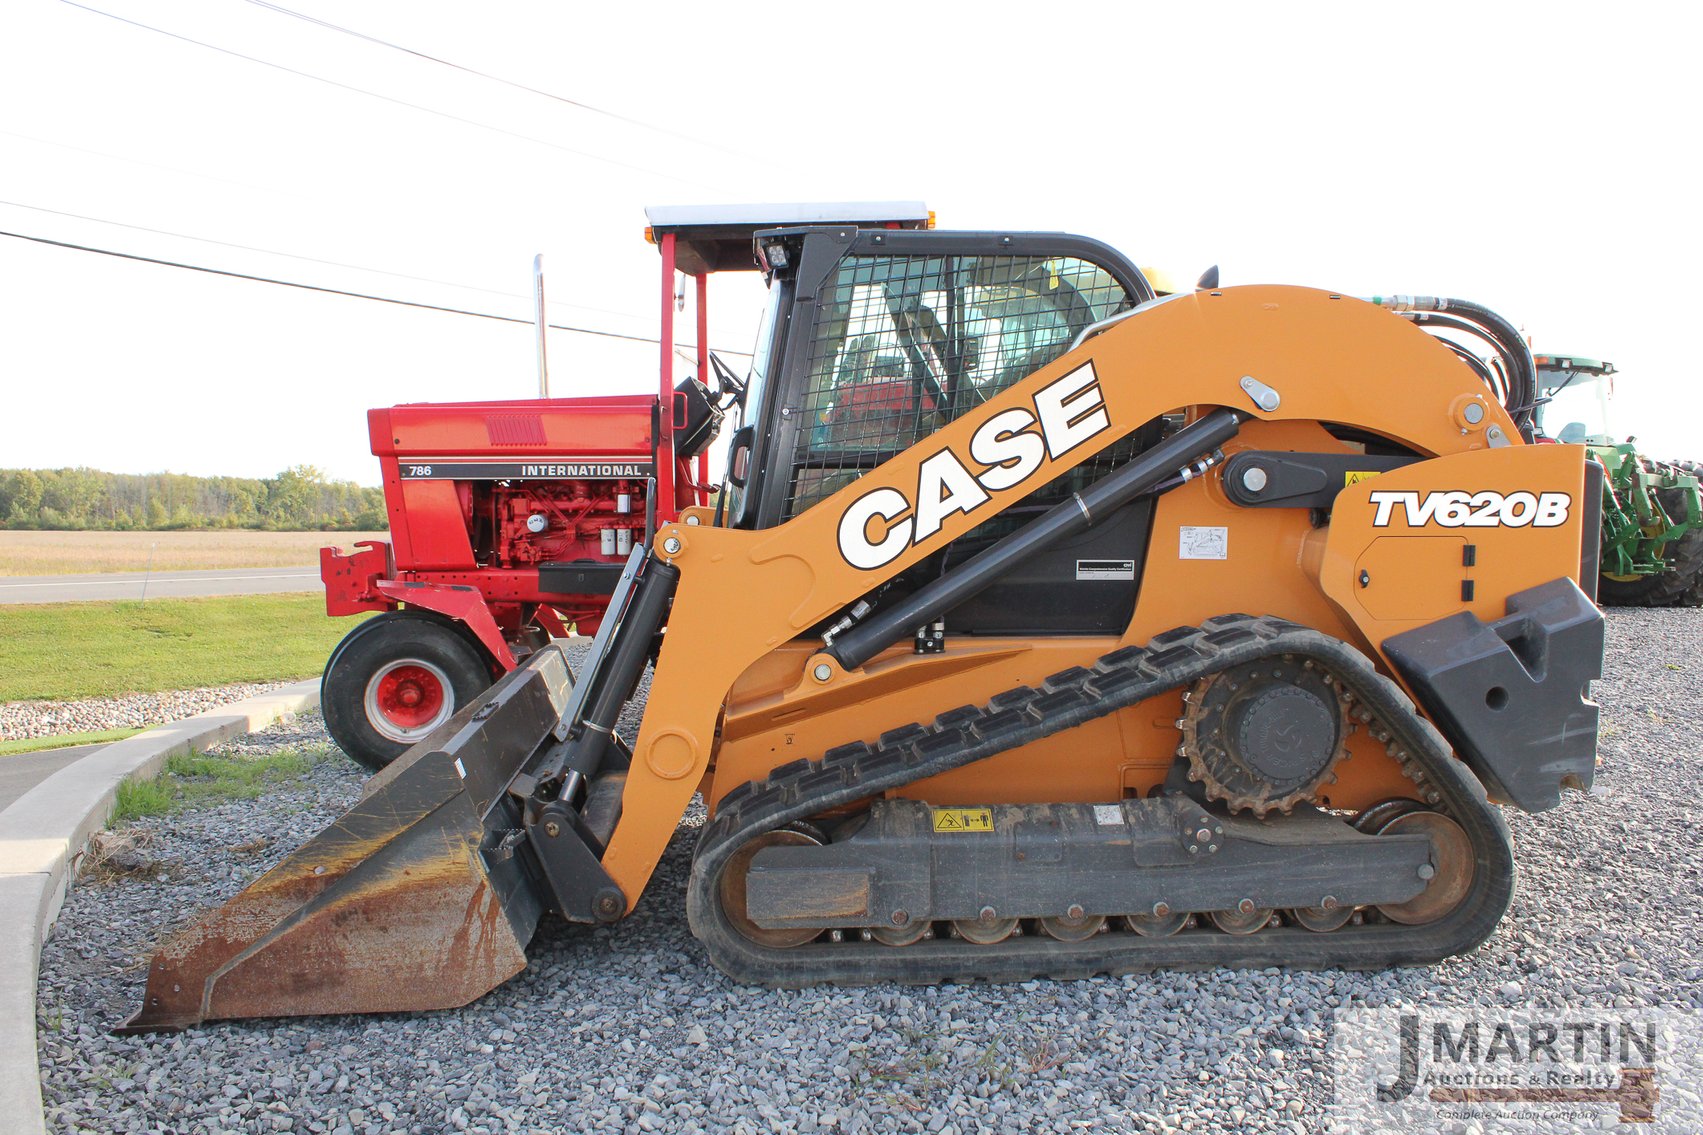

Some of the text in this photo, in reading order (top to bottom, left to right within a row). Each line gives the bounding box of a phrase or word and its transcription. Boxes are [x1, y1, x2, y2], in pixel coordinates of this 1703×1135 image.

[409, 465, 641, 476] 786 INTERNATIONAL
[837, 358, 1111, 571] CASE
[1369, 490, 1571, 527] TV620B
